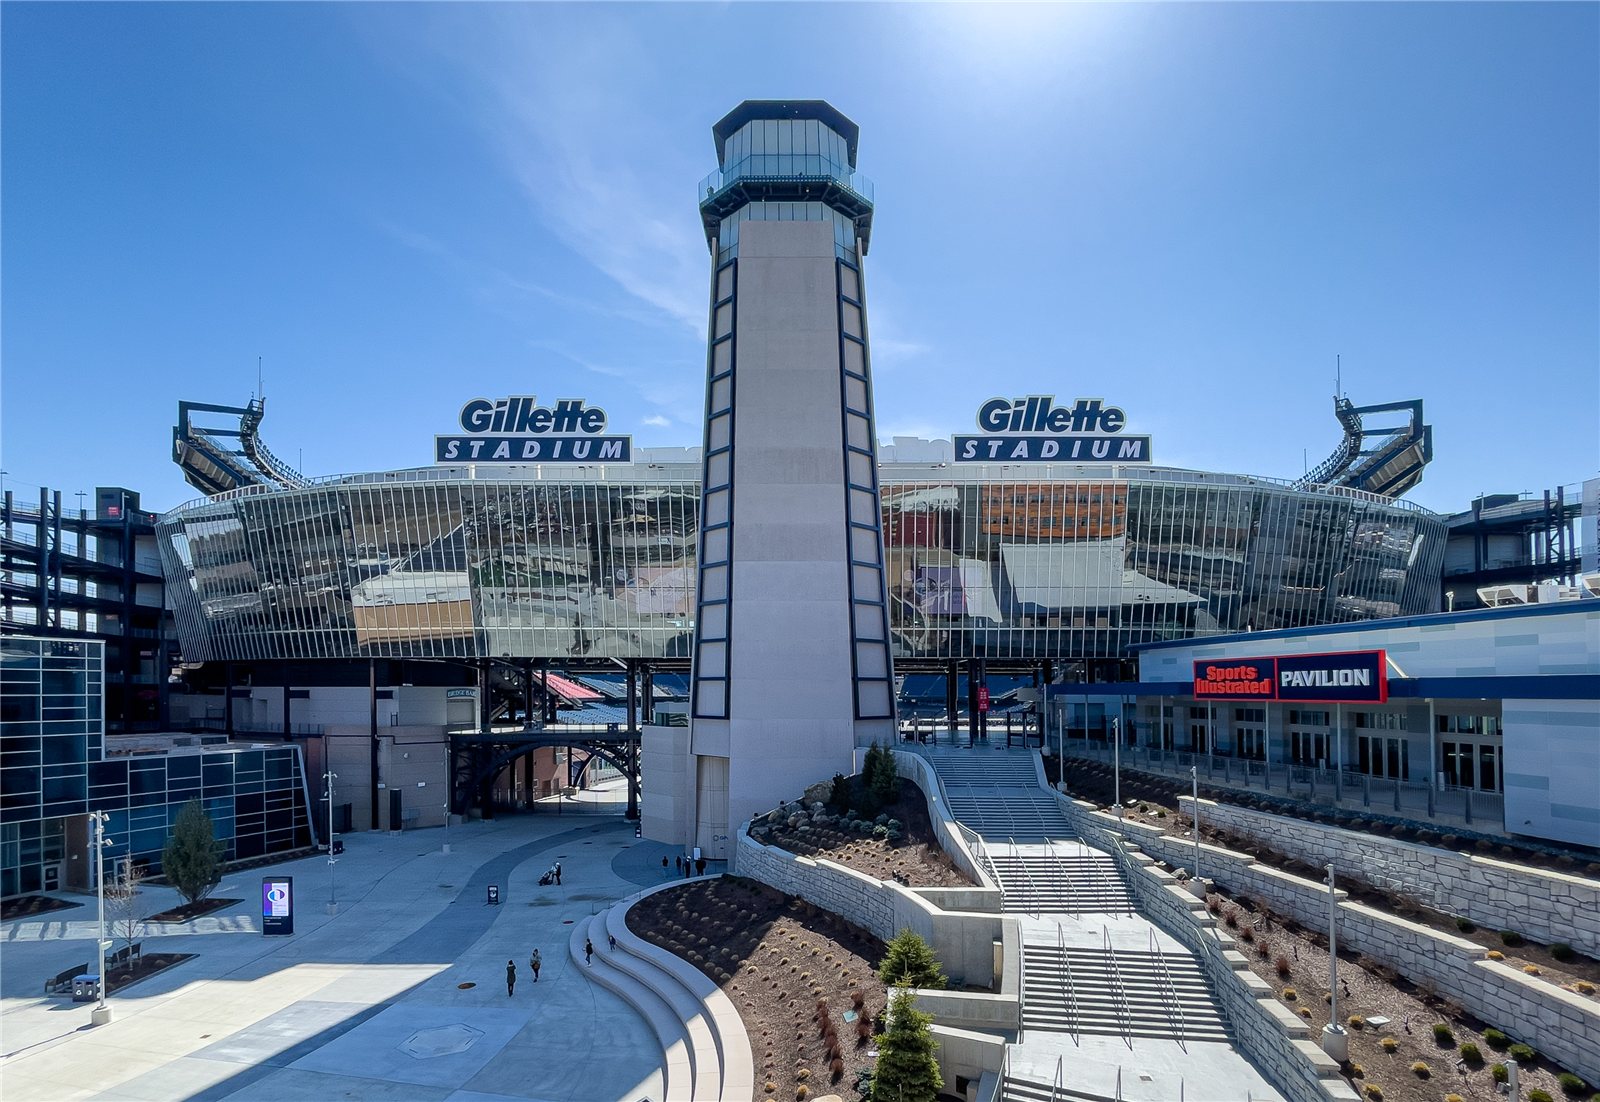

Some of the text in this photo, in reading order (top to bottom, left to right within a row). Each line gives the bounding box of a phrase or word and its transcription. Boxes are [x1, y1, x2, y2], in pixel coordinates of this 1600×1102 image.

[461, 397, 605, 434] Gillette
[979, 397, 1125, 433] Gillette
[445, 440, 622, 459] STADIUM
[962, 440, 1142, 459] STADIUM
[1206, 665, 1258, 681] Sports
[1281, 668, 1370, 687] PAVILION
[1196, 678, 1272, 694] Illustrated
